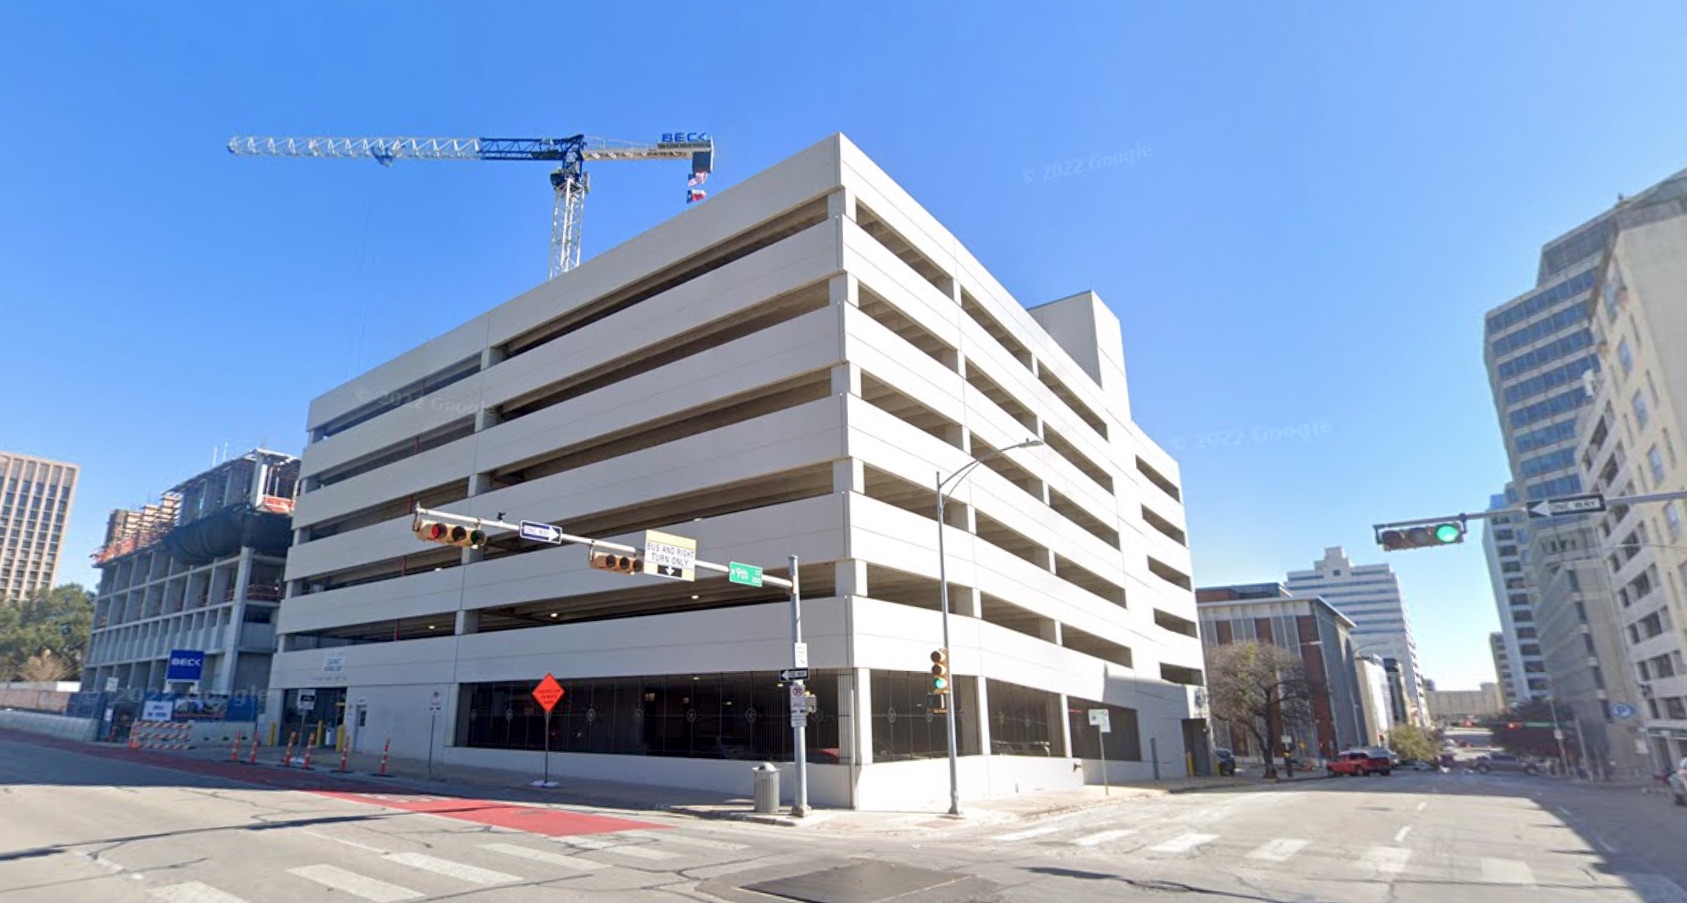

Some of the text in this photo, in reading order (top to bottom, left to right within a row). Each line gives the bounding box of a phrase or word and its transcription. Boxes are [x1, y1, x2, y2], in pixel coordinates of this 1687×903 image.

[662, 132, 711, 142] BECK
[647, 541, 694, 560] BUS AND RIGHT
[652, 552, 689, 567] TURN ONLY
[171, 657, 201, 667] BECK
